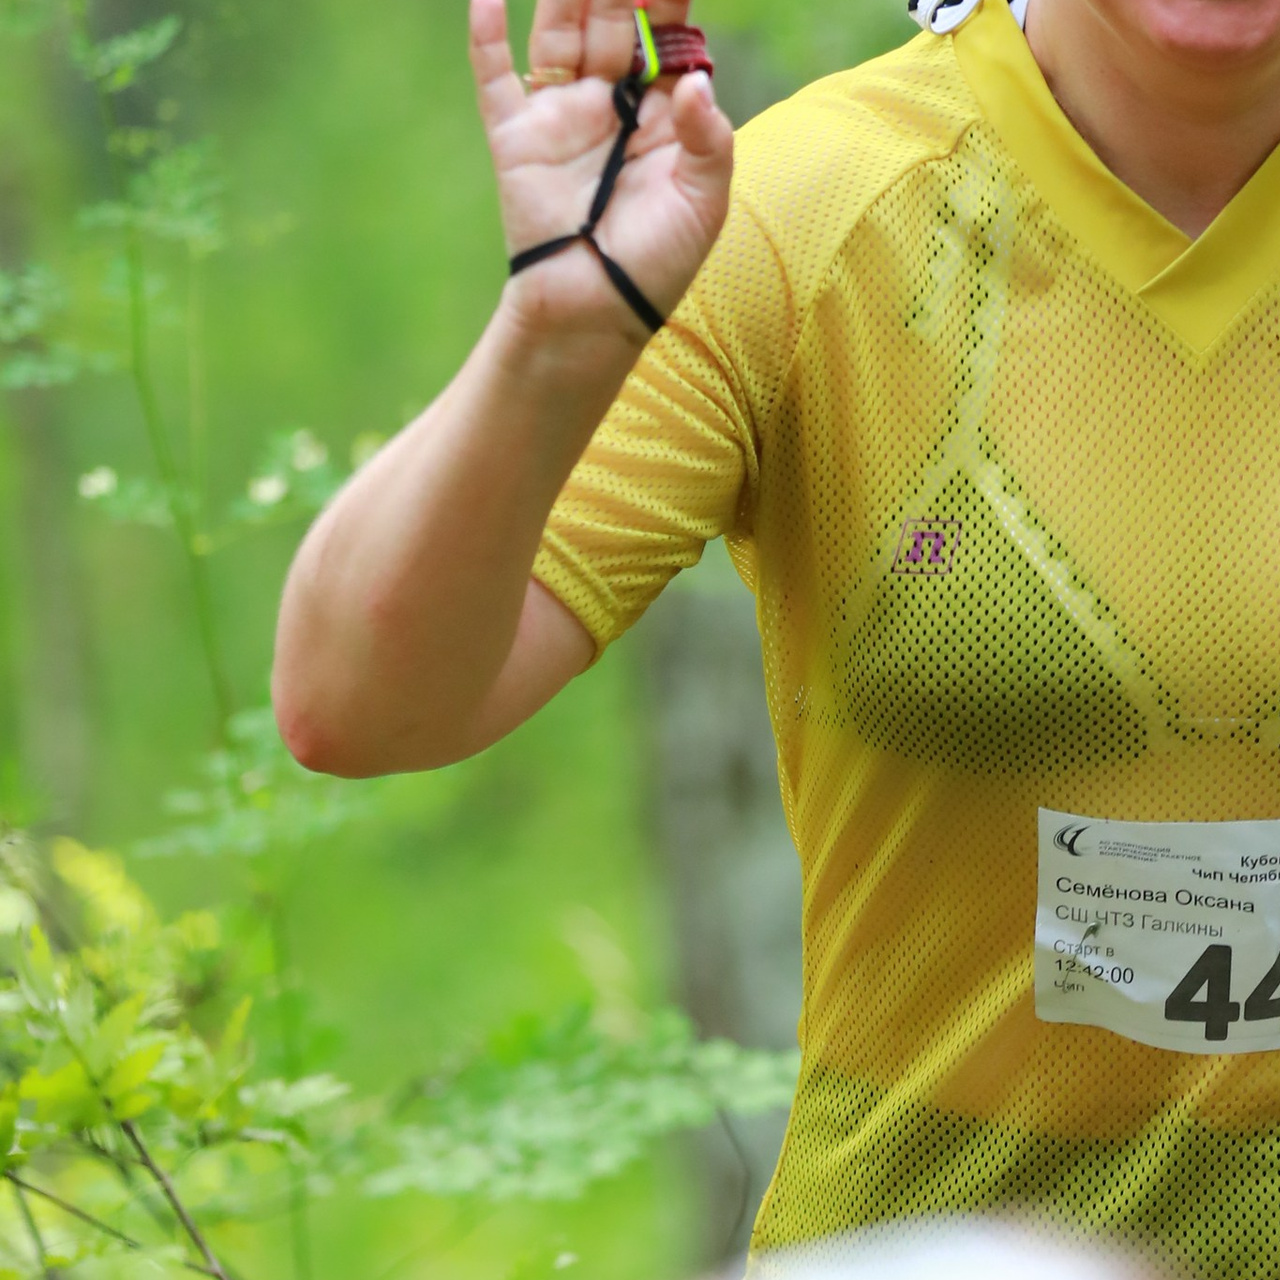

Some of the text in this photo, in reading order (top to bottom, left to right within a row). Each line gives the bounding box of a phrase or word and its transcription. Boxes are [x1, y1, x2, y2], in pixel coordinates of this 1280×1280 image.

[1192, 868, 1223, 882] ЧиП
[1056, 876, 1255, 913] Семёнова Оксана
[1055, 904, 1223, 937] СШ ЧТЗ Галкины
[1053, 939, 1115, 958] Старт в
[1055, 959, 1134, 984] 12:42:00
[1054, 981, 1085, 992] Чип
